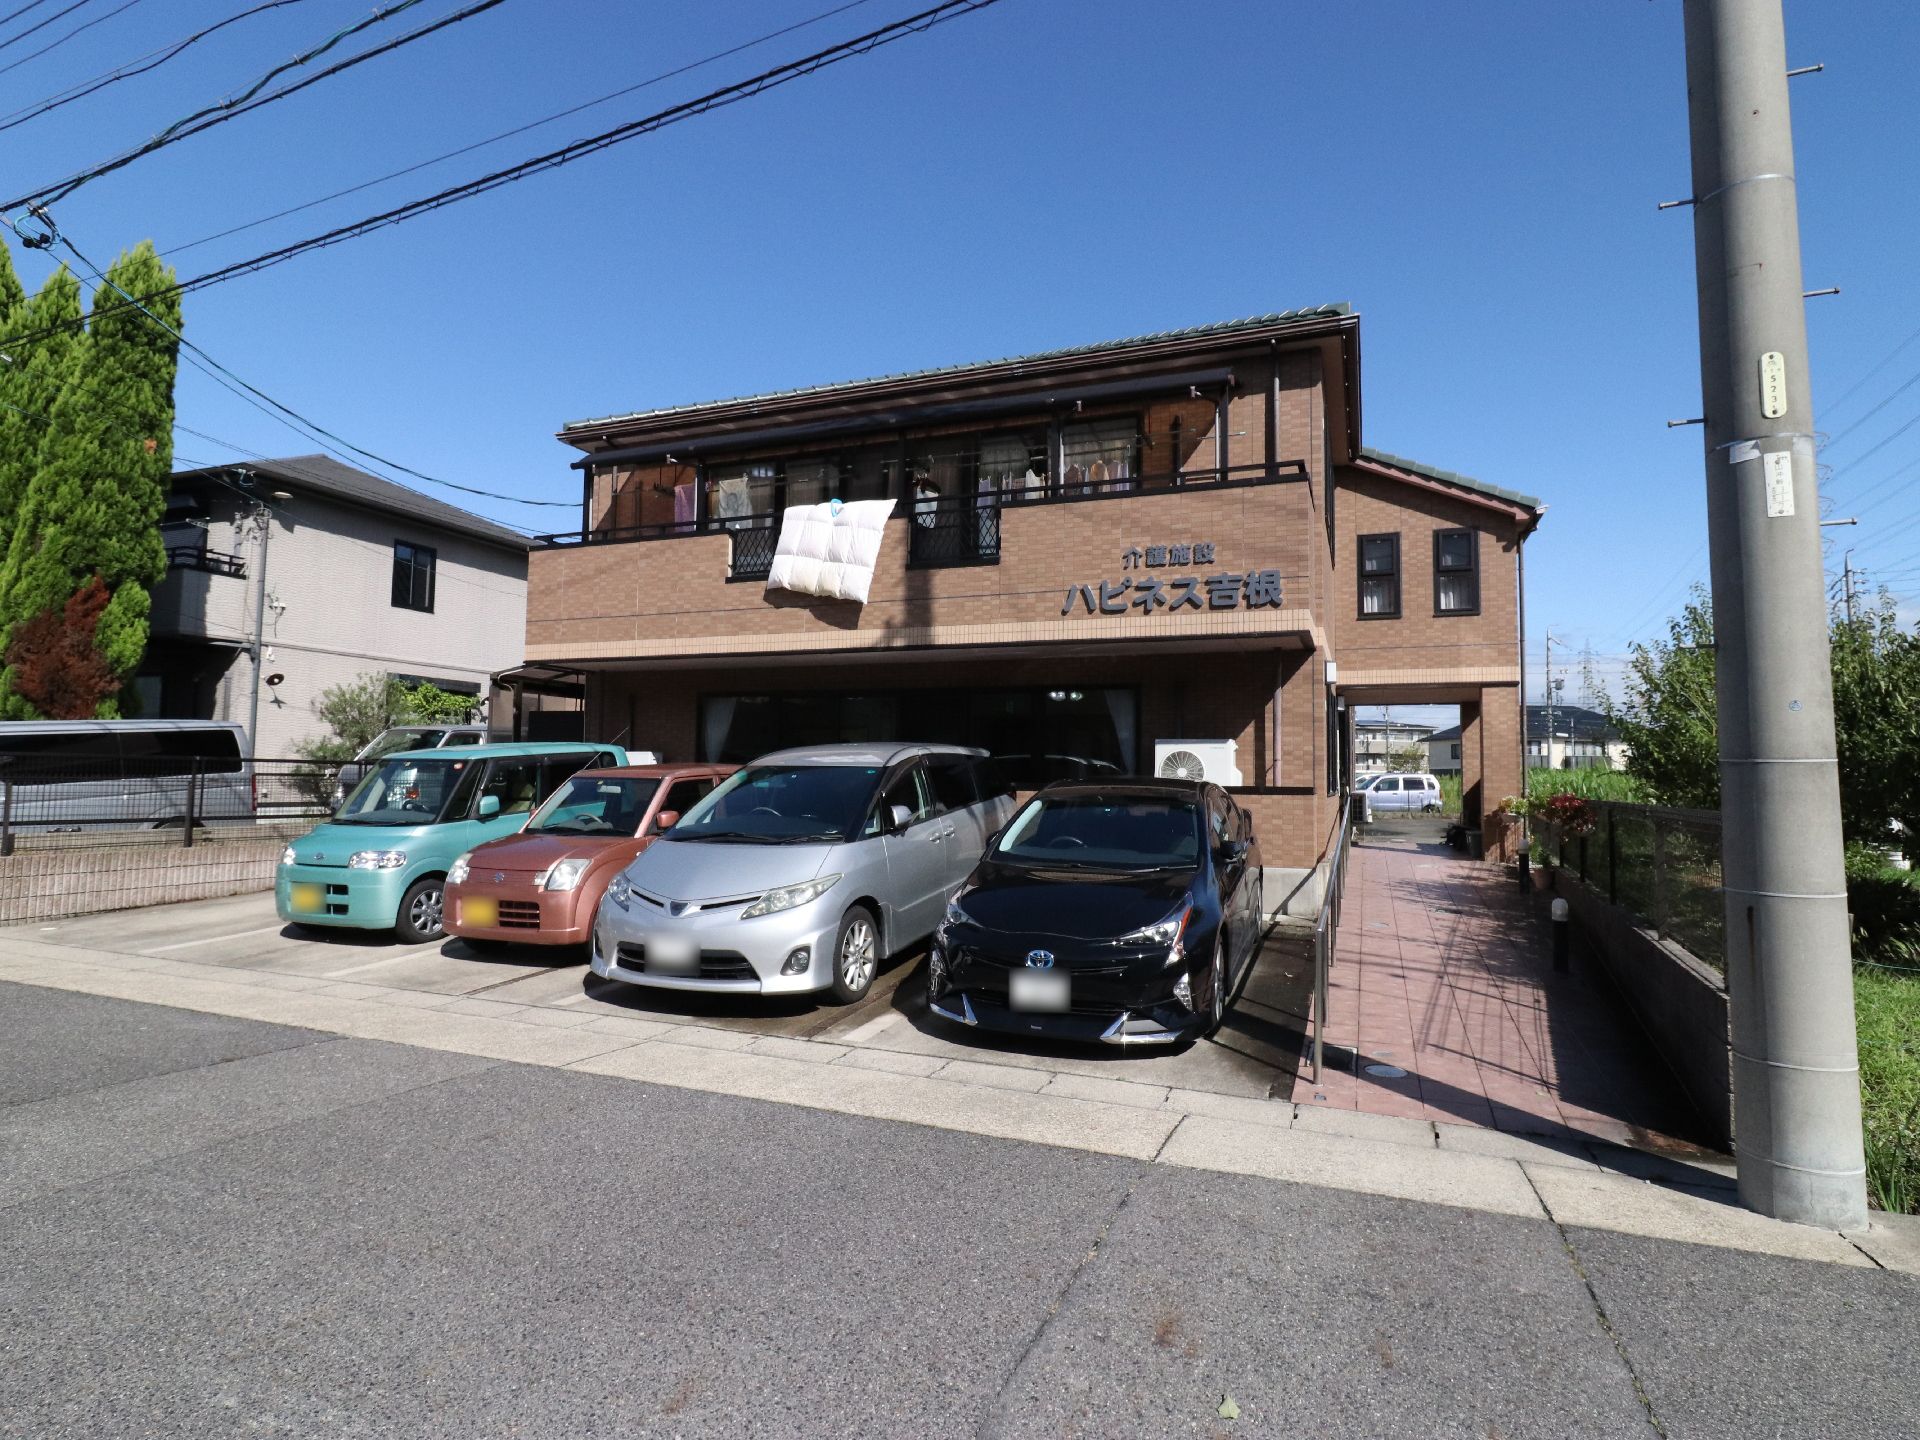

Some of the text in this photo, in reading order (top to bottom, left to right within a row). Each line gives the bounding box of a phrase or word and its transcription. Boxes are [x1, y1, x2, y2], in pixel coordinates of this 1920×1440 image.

[1122, 541, 1216, 570] 介護施設
[1061, 569, 1284, 616] ハピネス吉根
